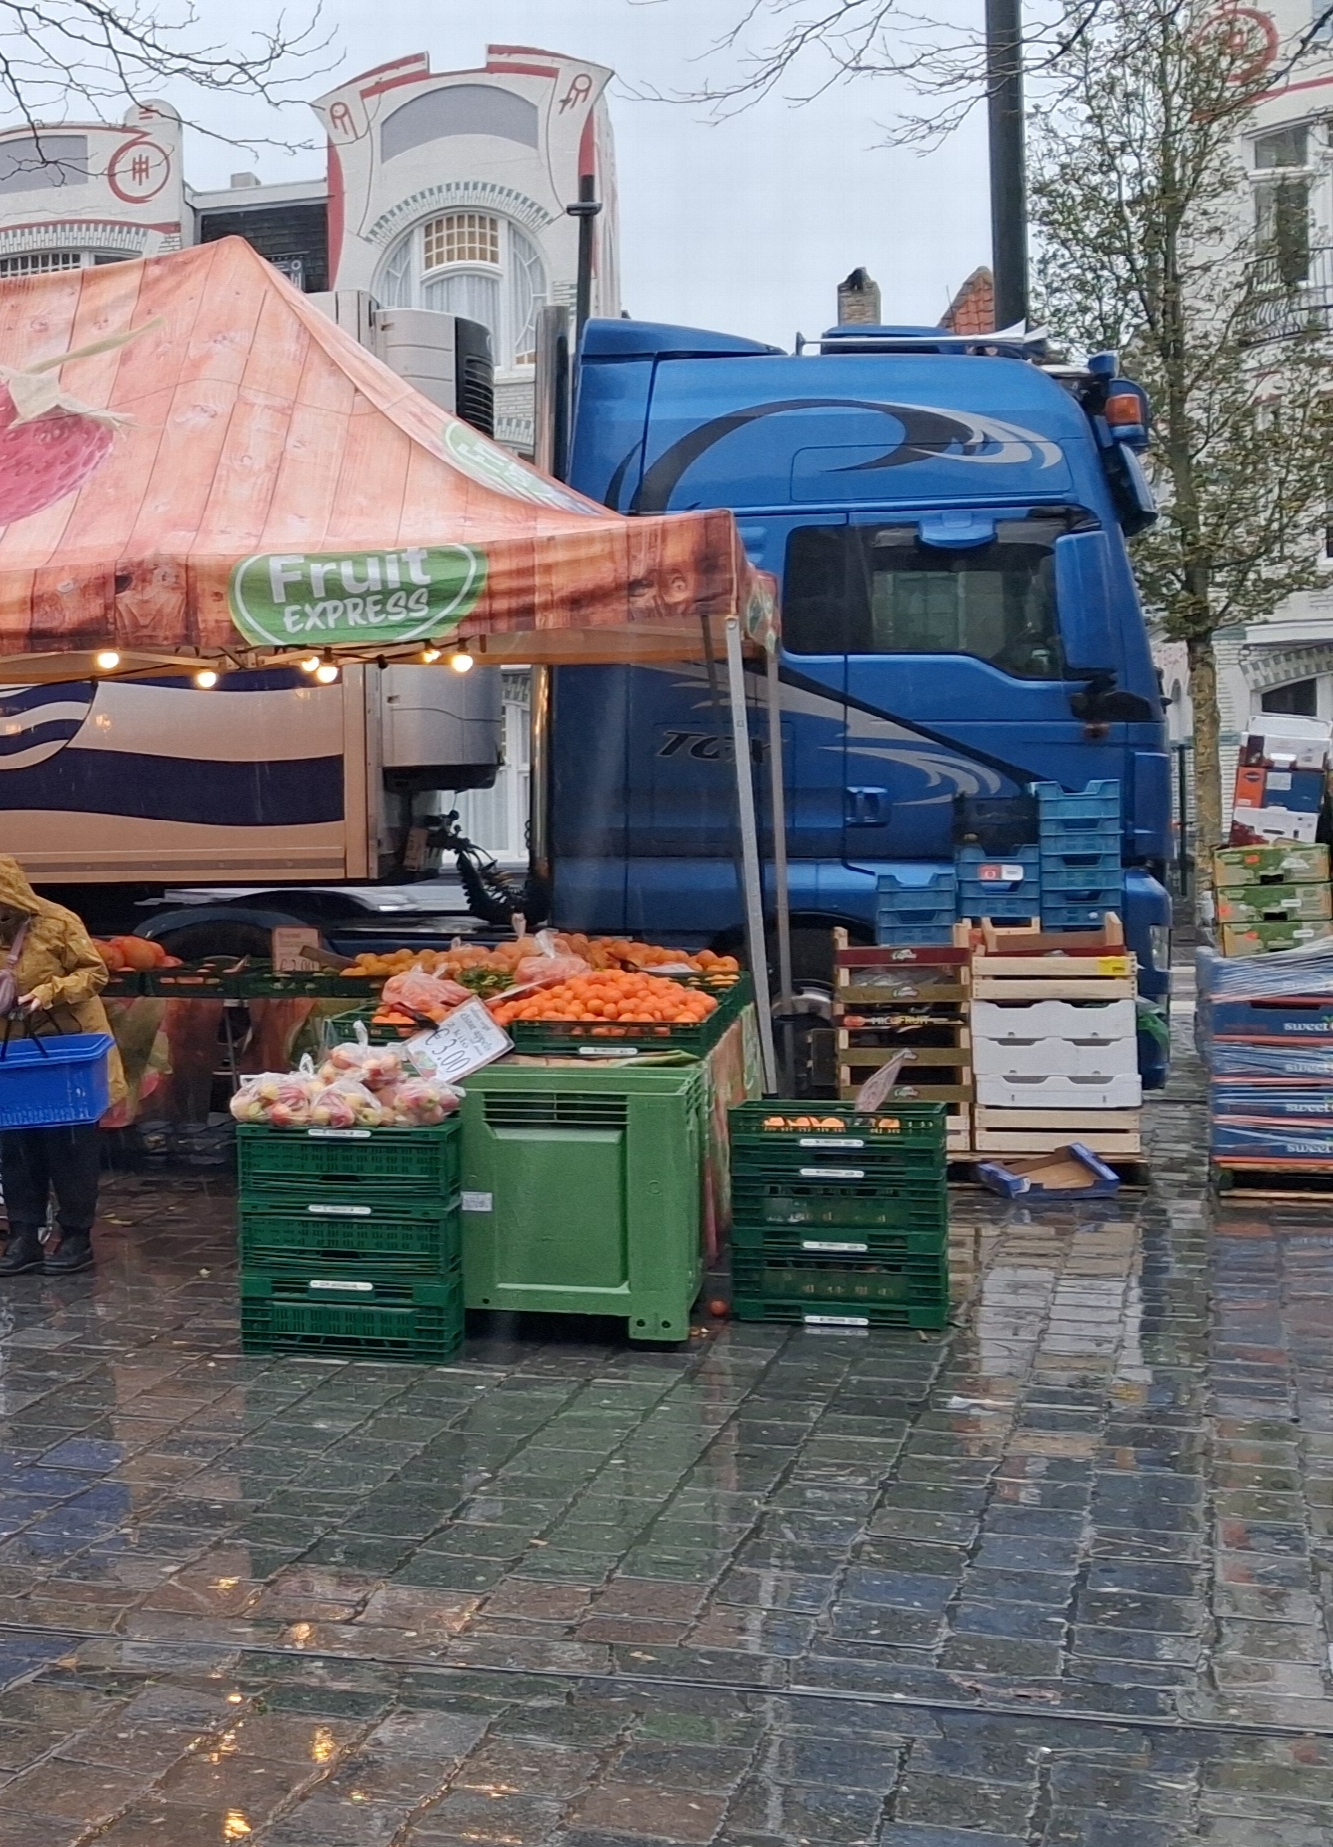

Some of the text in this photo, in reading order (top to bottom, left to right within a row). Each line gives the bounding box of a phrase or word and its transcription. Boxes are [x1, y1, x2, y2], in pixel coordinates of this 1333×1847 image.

[269, 547, 432, 604] Fruit
[284, 588, 430, 634] EXPRESS
[1284, 1022, 1329, 1031] sweet
[1286, 1103, 1331, 1113] sweet
[1287, 1144, 1333, 1153] sweet
